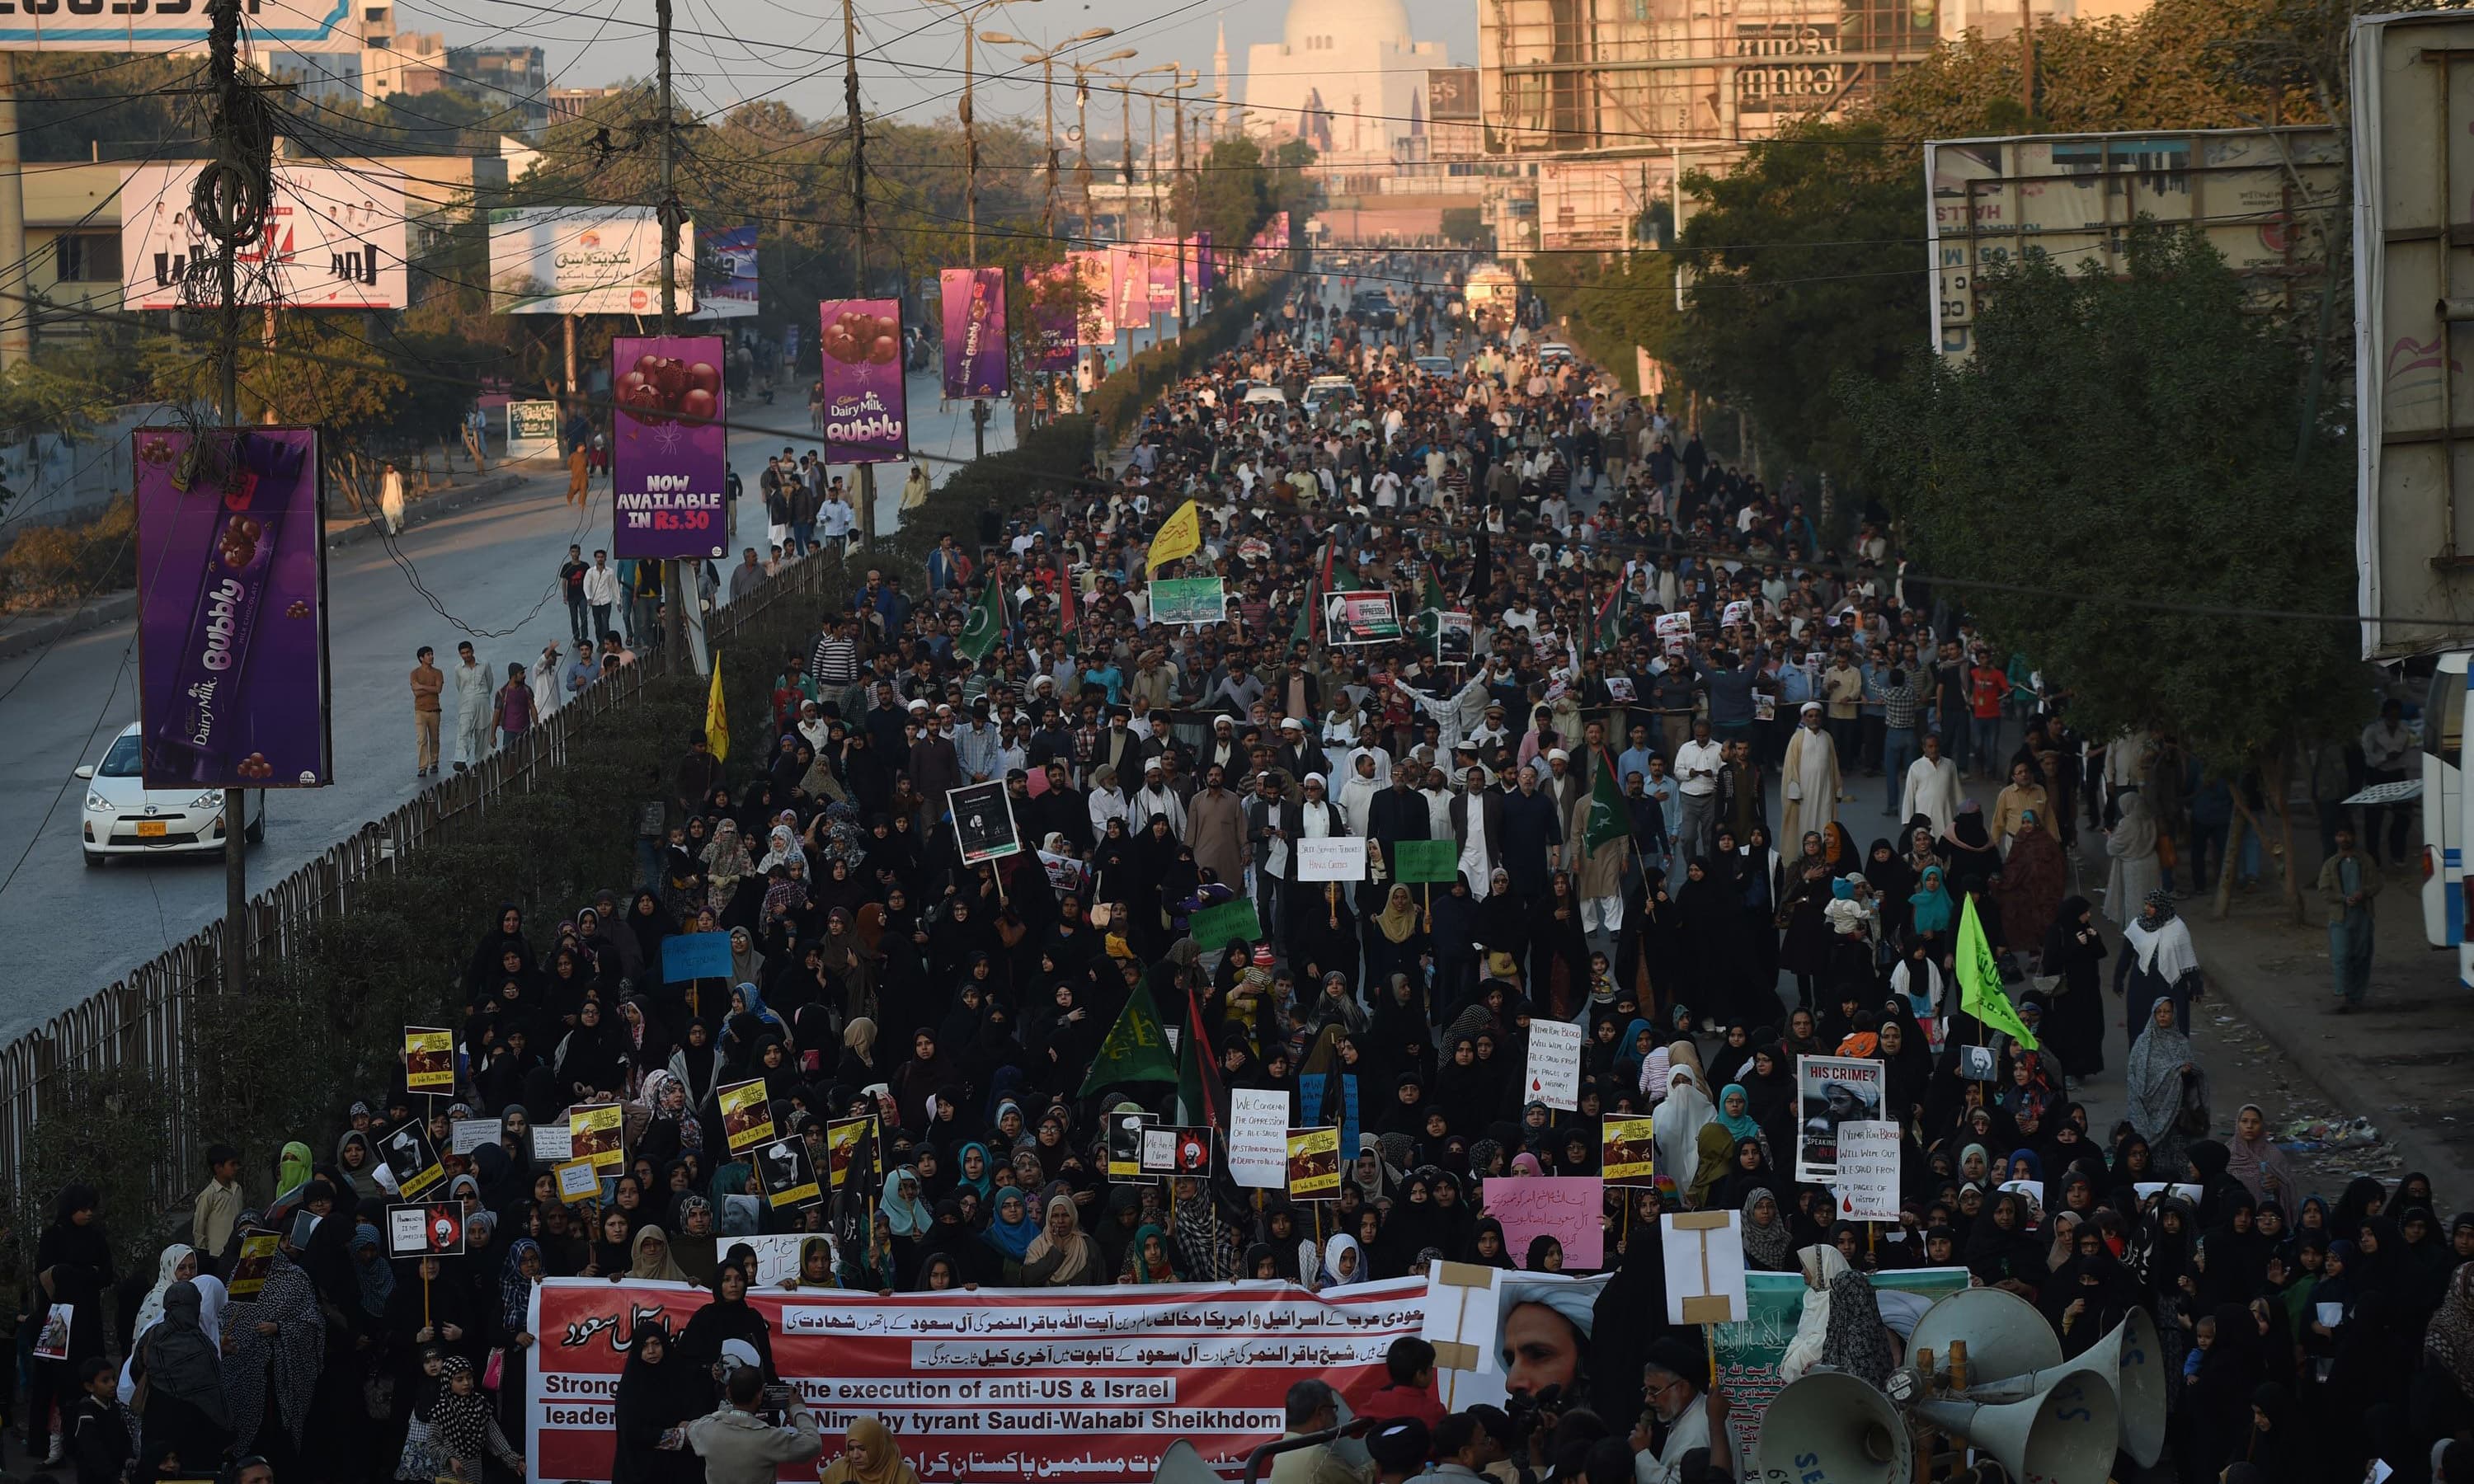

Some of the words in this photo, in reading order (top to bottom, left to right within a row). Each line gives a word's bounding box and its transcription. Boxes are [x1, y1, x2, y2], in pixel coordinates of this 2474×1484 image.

[1935, 205, 2001, 221] HALLS
[830, 405, 860, 417] Dairy
[826, 413, 902, 442] Bubbly
[647, 475, 690, 492] NOW
[617, 493, 722, 510] AVAILABLE
[628, 511, 651, 528] IN
[654, 510, 710, 530] Rs.30
[203, 578, 245, 672] Bubbly
[192, 707, 214, 747] Dairy
[1809, 1066, 1829, 1078] HIS
[1832, 1068, 1878, 1082] CRIME?
[1233, 1129, 1244, 1138] OF
[1881, 1148, 1897, 1158] OUT
[1877, 1184, 1888, 1192] OF
[910, 1318, 954, 1333] سعود
[985, 1315, 1028, 1333] النمر
[1029, 1315, 1059, 1333] باقر
[1153, 1310, 1203, 1328] مخالف
[1262, 1308, 1324, 1331] اسرائیل
[562, 1314, 619, 1347] سعود
[1070, 1345, 1114, 1366] تابوت
[1136, 1347, 1180, 1364] سعود
[1246, 1345, 1287, 1365] النمر
[1288, 1345, 1319, 1364] باقر
[1319, 1345, 1356, 1365] شیخ
[838, 1381, 950, 1399] execution
[957, 1381, 981, 1399] of
[988, 1379, 1073, 1400] anti-US
[1079, 1380, 1096, 1399] &
[1103, 1380, 1169, 1399] Israel
[877, 1411, 905, 1434] by
[911, 1412, 981, 1435] tyrant
[987, 1411, 1144, 1430] Saudi-Wahabi
[1150, 1410, 1282, 1429] Sheikhdom
[953, 1452, 1036, 1481] پاکستان
[1036, 1452, 1127, 1477] مسلمین
